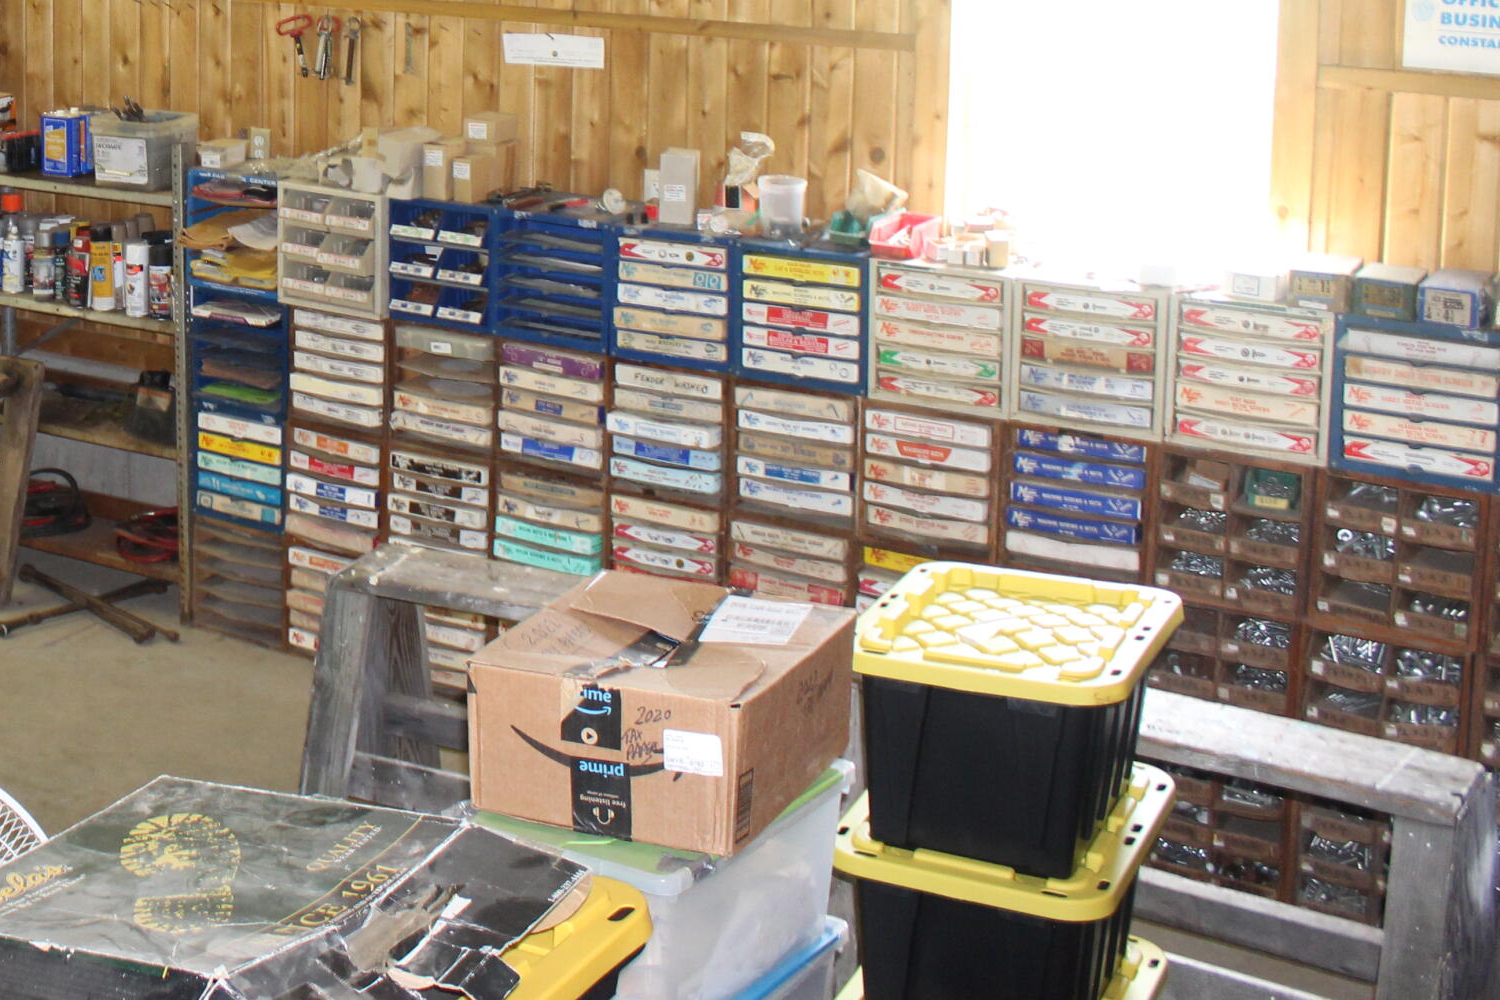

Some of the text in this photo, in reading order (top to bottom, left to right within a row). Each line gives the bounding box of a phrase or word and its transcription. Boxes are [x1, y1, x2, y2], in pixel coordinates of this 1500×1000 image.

[1438, 35, 1500, 49] CONSTA
[579, 688, 612, 703] ime
[635, 706, 672, 725] 2020
[621, 728, 643, 745] TAX
[579, 760, 625, 778] prime
[580, 794, 627, 808] free listening
[306, 820, 377, 872] QUALITY
[342, 864, 400, 900] 1961
